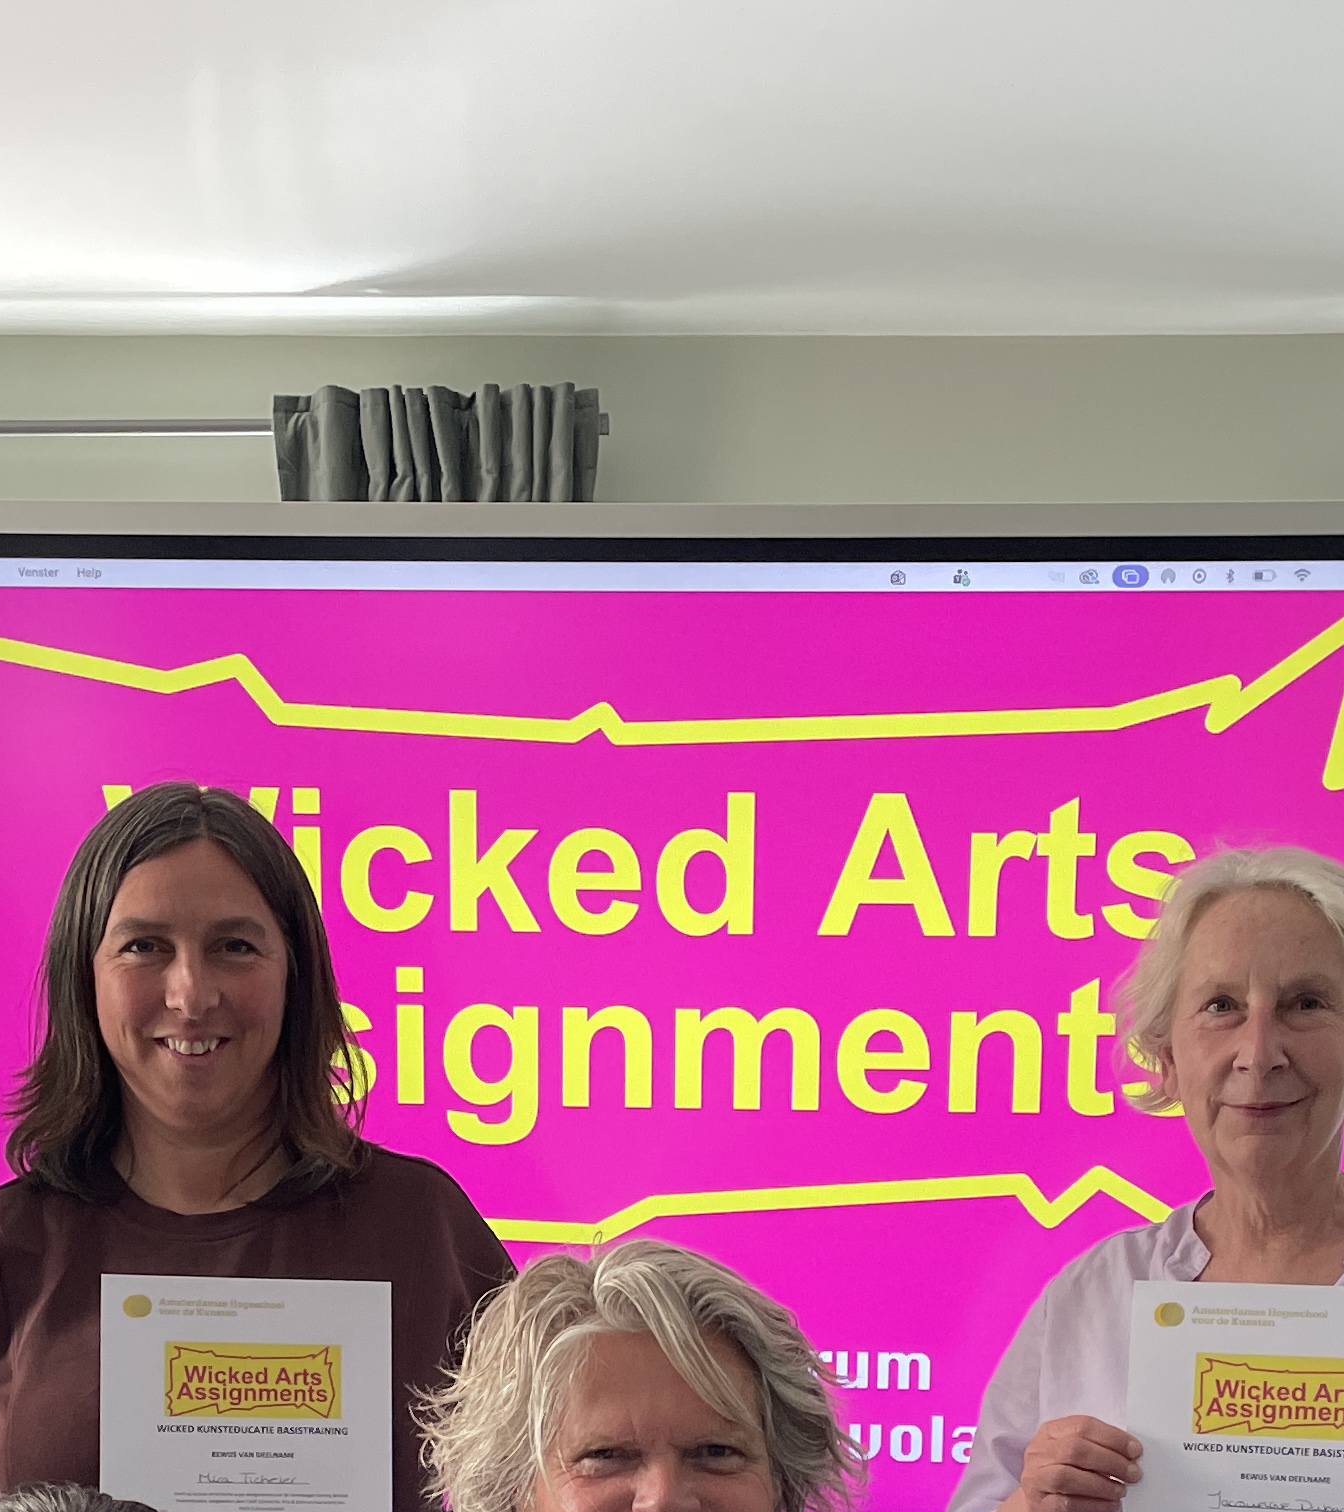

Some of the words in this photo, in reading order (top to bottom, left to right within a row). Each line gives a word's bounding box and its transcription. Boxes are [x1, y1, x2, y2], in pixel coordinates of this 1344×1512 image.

[18, 567, 59, 578] Venster
[76, 567, 102, 579] Help
[102, 785, 755, 935] icked
[817, 791, 1197, 941] Arts
[328, 967, 1187, 1145] signment
[184, 1365, 268, 1385] Wicked
[275, 1367, 322, 1386] Arts
[176, 1382, 328, 1406] Assignments
[1215, 1379, 1306, 1402] Wicked
[157, 1424, 194, 1434] WICKED
[196, 1425, 274, 1435] KUNSTEDUCATIE
[277, 1426, 348, 1435] BASISTRAINING
[1183, 1442, 1223, 1453] WICKED
[1226, 1444, 1310, 1457] KUNSTEDUCATIE
